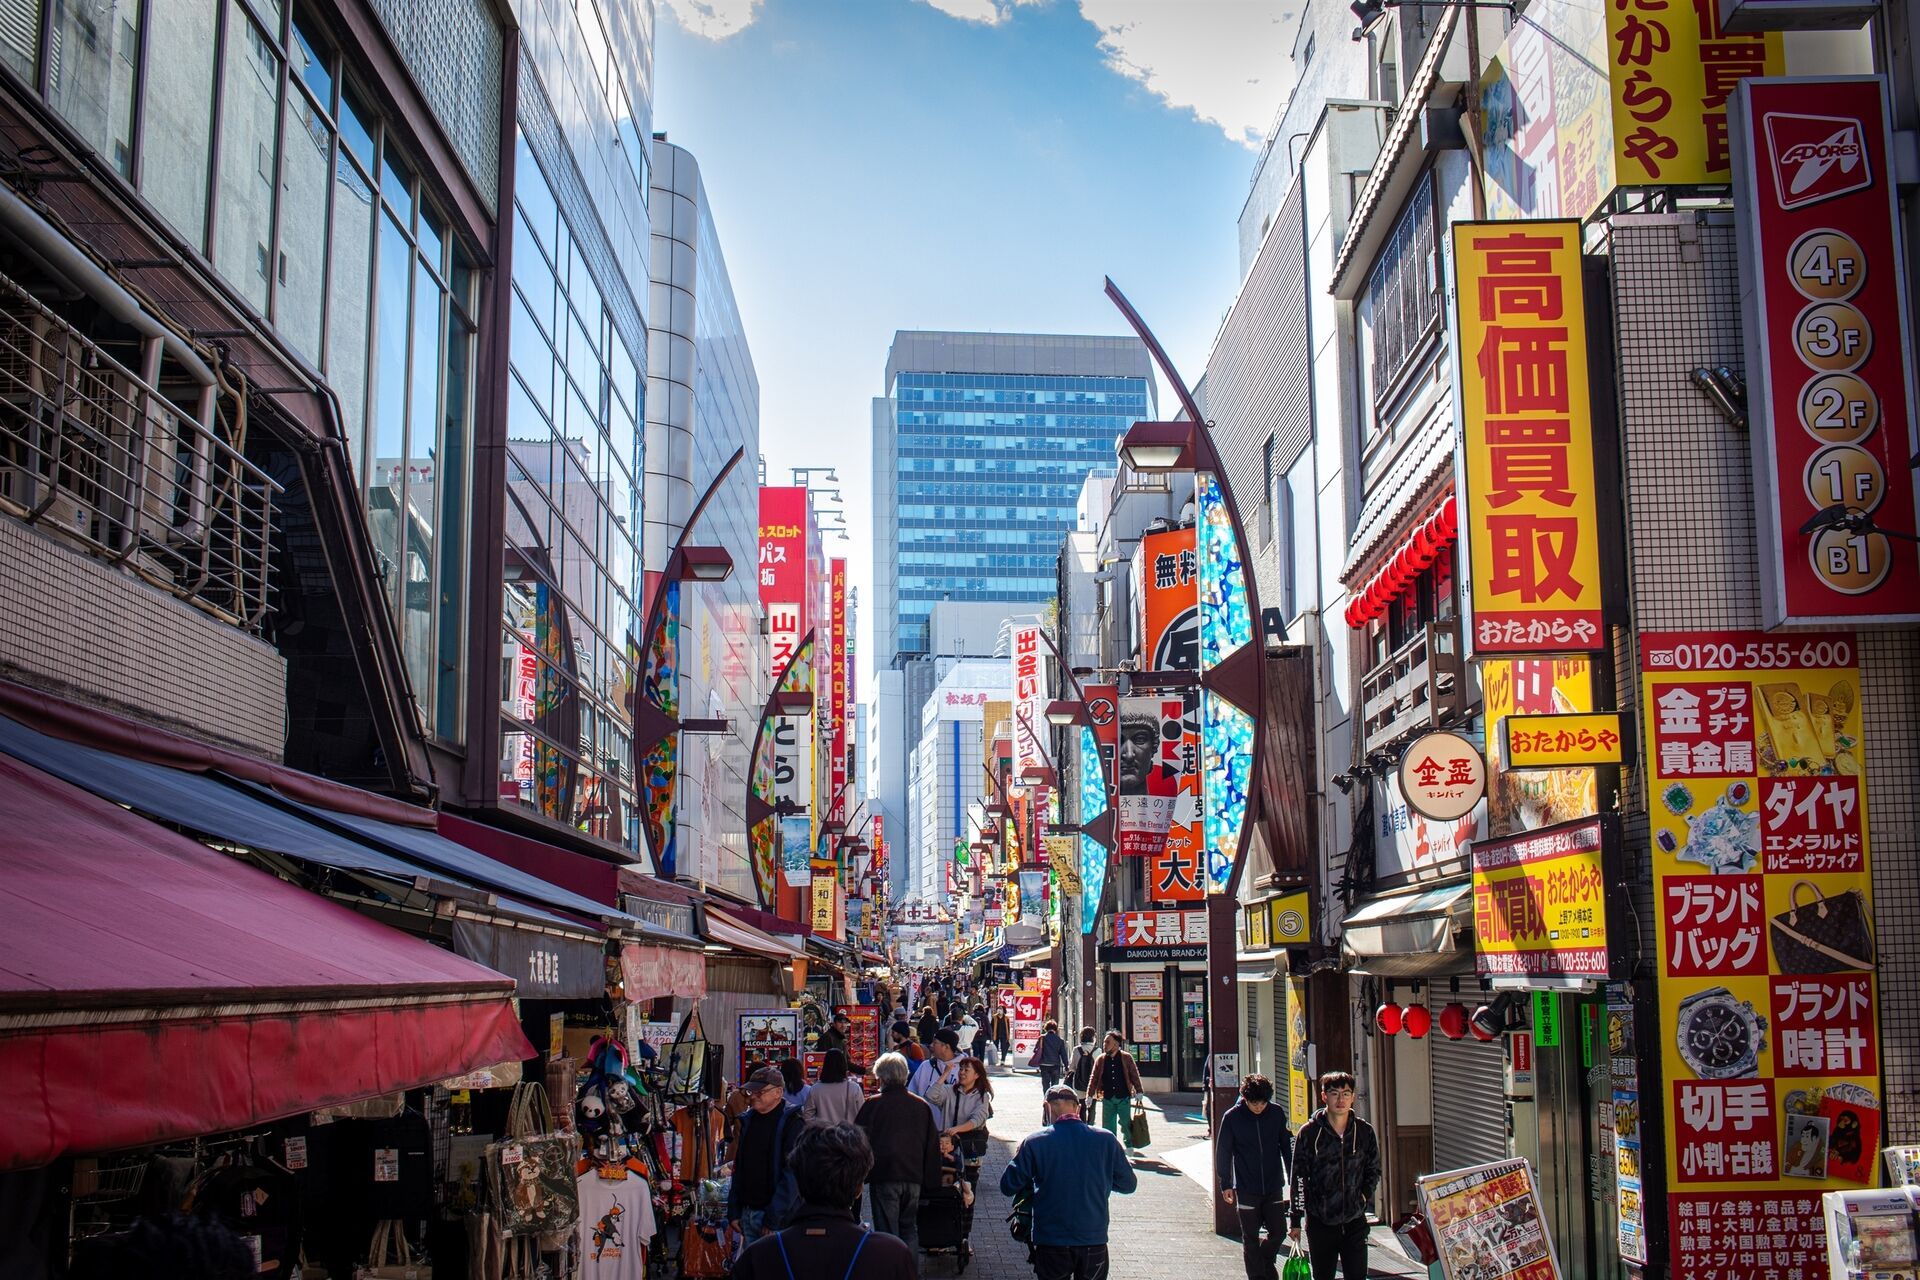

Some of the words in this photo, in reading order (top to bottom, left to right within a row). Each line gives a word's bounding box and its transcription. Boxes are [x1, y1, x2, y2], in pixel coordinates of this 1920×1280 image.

[1614, 0, 1679, 179] からや
[1782, 144, 1860, 164] ADORES
[1801, 246, 1854, 285] 4F
[1806, 316, 1860, 357] 3F
[1473, 233, 1584, 603] 高価買取
[1813, 388, 1866, 429] 2F
[1820, 460, 1873, 502] 1F
[1478, 617, 1597, 645] おたからや
[1674, 641, 1850, 670] 0120-555-600
[946, 692, 988, 707] 松坂屋
[1657, 687, 1702, 734] 金
[1707, 687, 1747, 710] プラ
[1511, 728, 1619, 754] おたからや
[1708, 712, 1750, 736] チナ
[1661, 741, 1753, 775] 貴金属
[1765, 781, 1856, 831] ダイヤ
[1766, 832, 1859, 851] エメラルド
[1768, 852, 1859, 870] ルビー・サファイア
[1548, 864, 1602, 905] おたからや
[1669, 882, 1760, 925] ブランド
[1475, 875, 1547, 943] 高価買取
[1127, 950, 1169, 958] DAIKOKU-YA
[1557, 951, 1607, 971] 0120-555-600
[1671, 927, 1761, 970] バッグ
[1775, 981, 1869, 1021] ブランド
[1782, 1028, 1868, 1070] 時計
[1680, 1083, 1770, 1132] 切手
[1682, 1141, 1773, 1177] 小判・古銭
